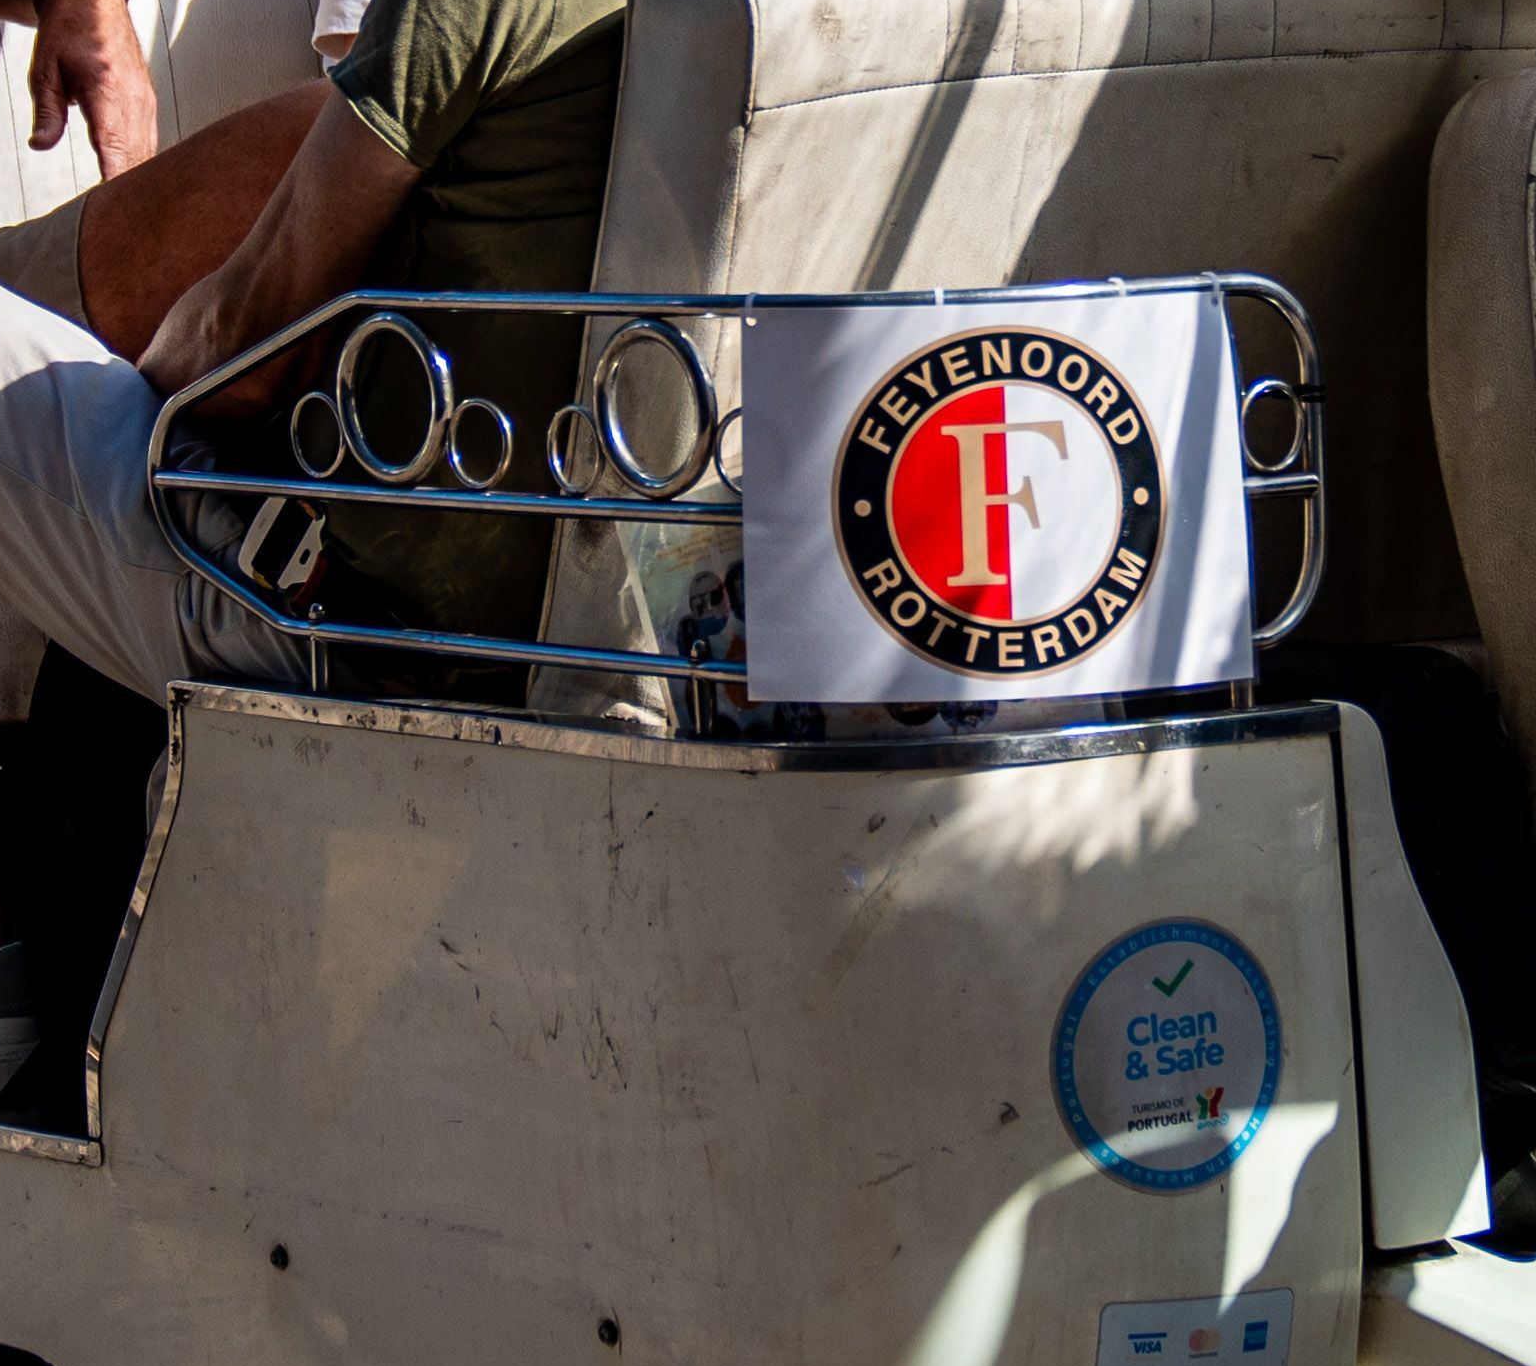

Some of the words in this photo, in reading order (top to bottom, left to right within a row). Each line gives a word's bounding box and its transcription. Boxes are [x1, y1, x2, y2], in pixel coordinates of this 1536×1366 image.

[858, 338, 1141, 455] FEYENOORD
[941, 420, 1069, 587] F
[862, 546, 1148, 668] ROTTERDAM
[1127, 1011, 1218, 1047] Clean
[1125, 1050, 1150, 1081] &
[1156, 1037, 1225, 1077] Safe
[1127, 1111, 1194, 1132] PORTUGAL
[1131, 1098, 1172, 1115] TURISMO
[1173, 1097, 1186, 1111] DE
[1133, 1341, 1162, 1355] VISA
